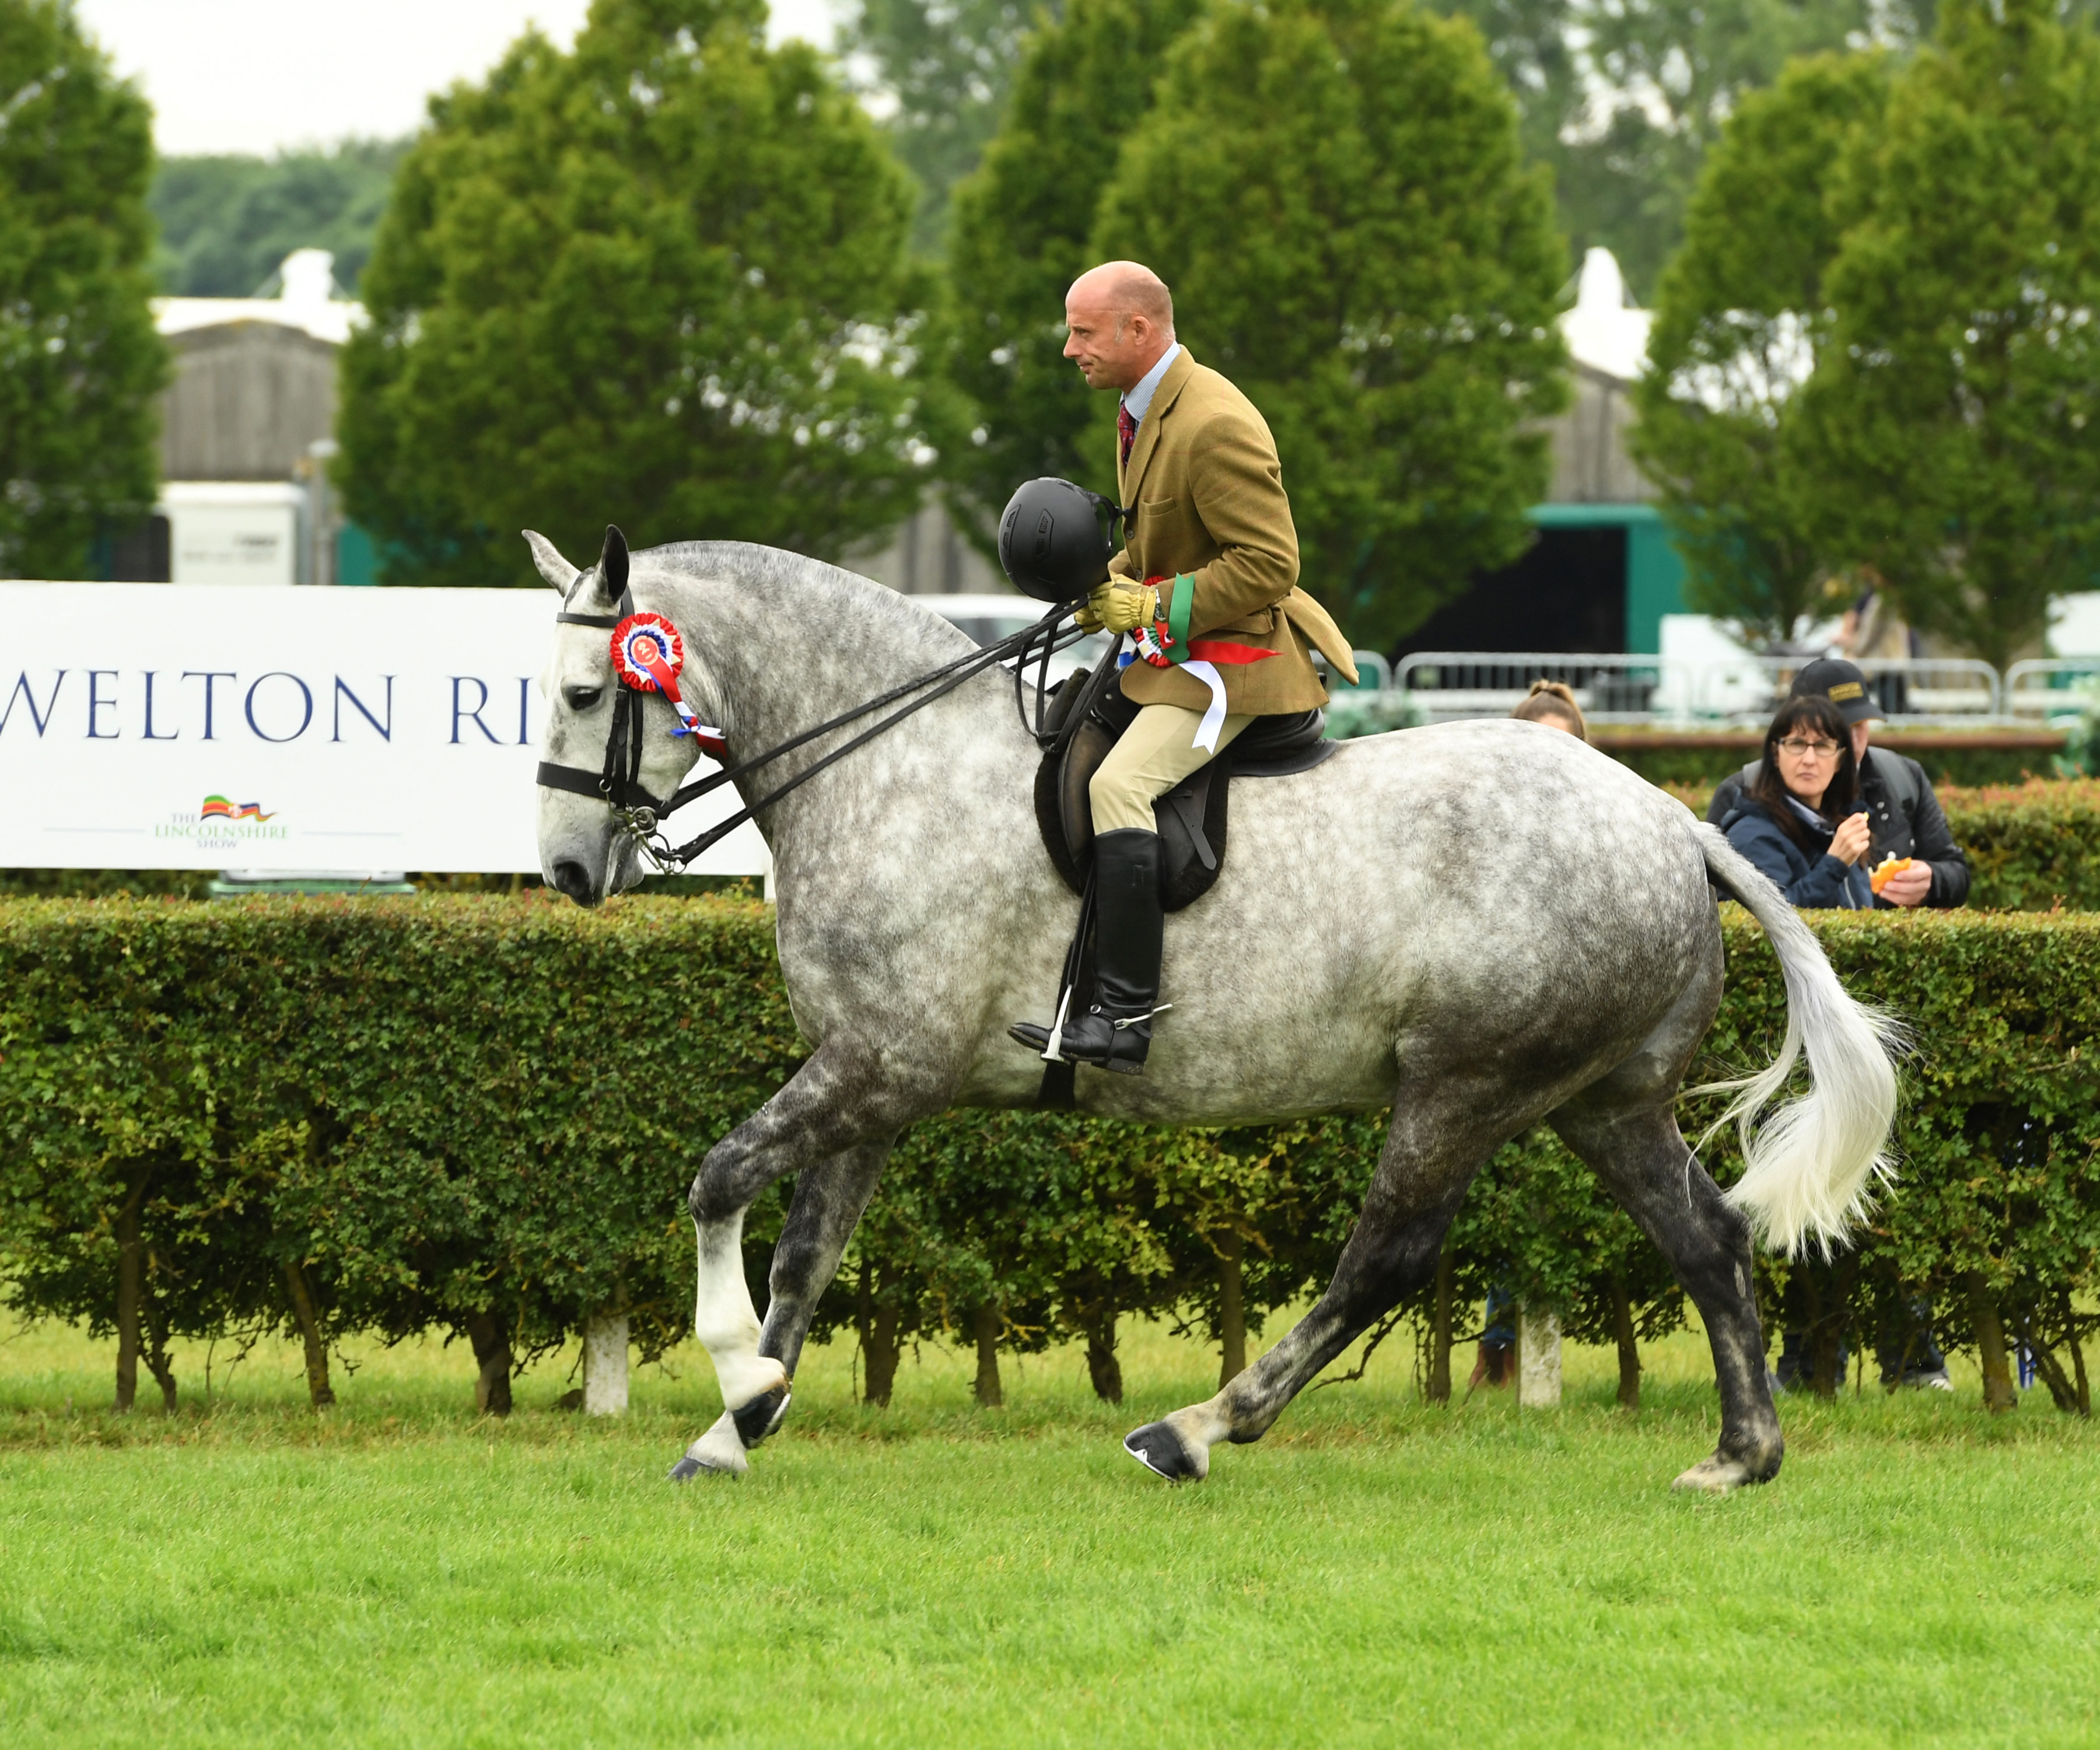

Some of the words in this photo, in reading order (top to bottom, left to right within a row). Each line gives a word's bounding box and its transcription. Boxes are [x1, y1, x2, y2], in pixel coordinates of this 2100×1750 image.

[0, 669, 397, 744] WELTON
[172, 813, 196, 824] THE
[155, 824, 289, 839] LINCOLNSHIRE
[197, 838, 238, 849] SHOW
